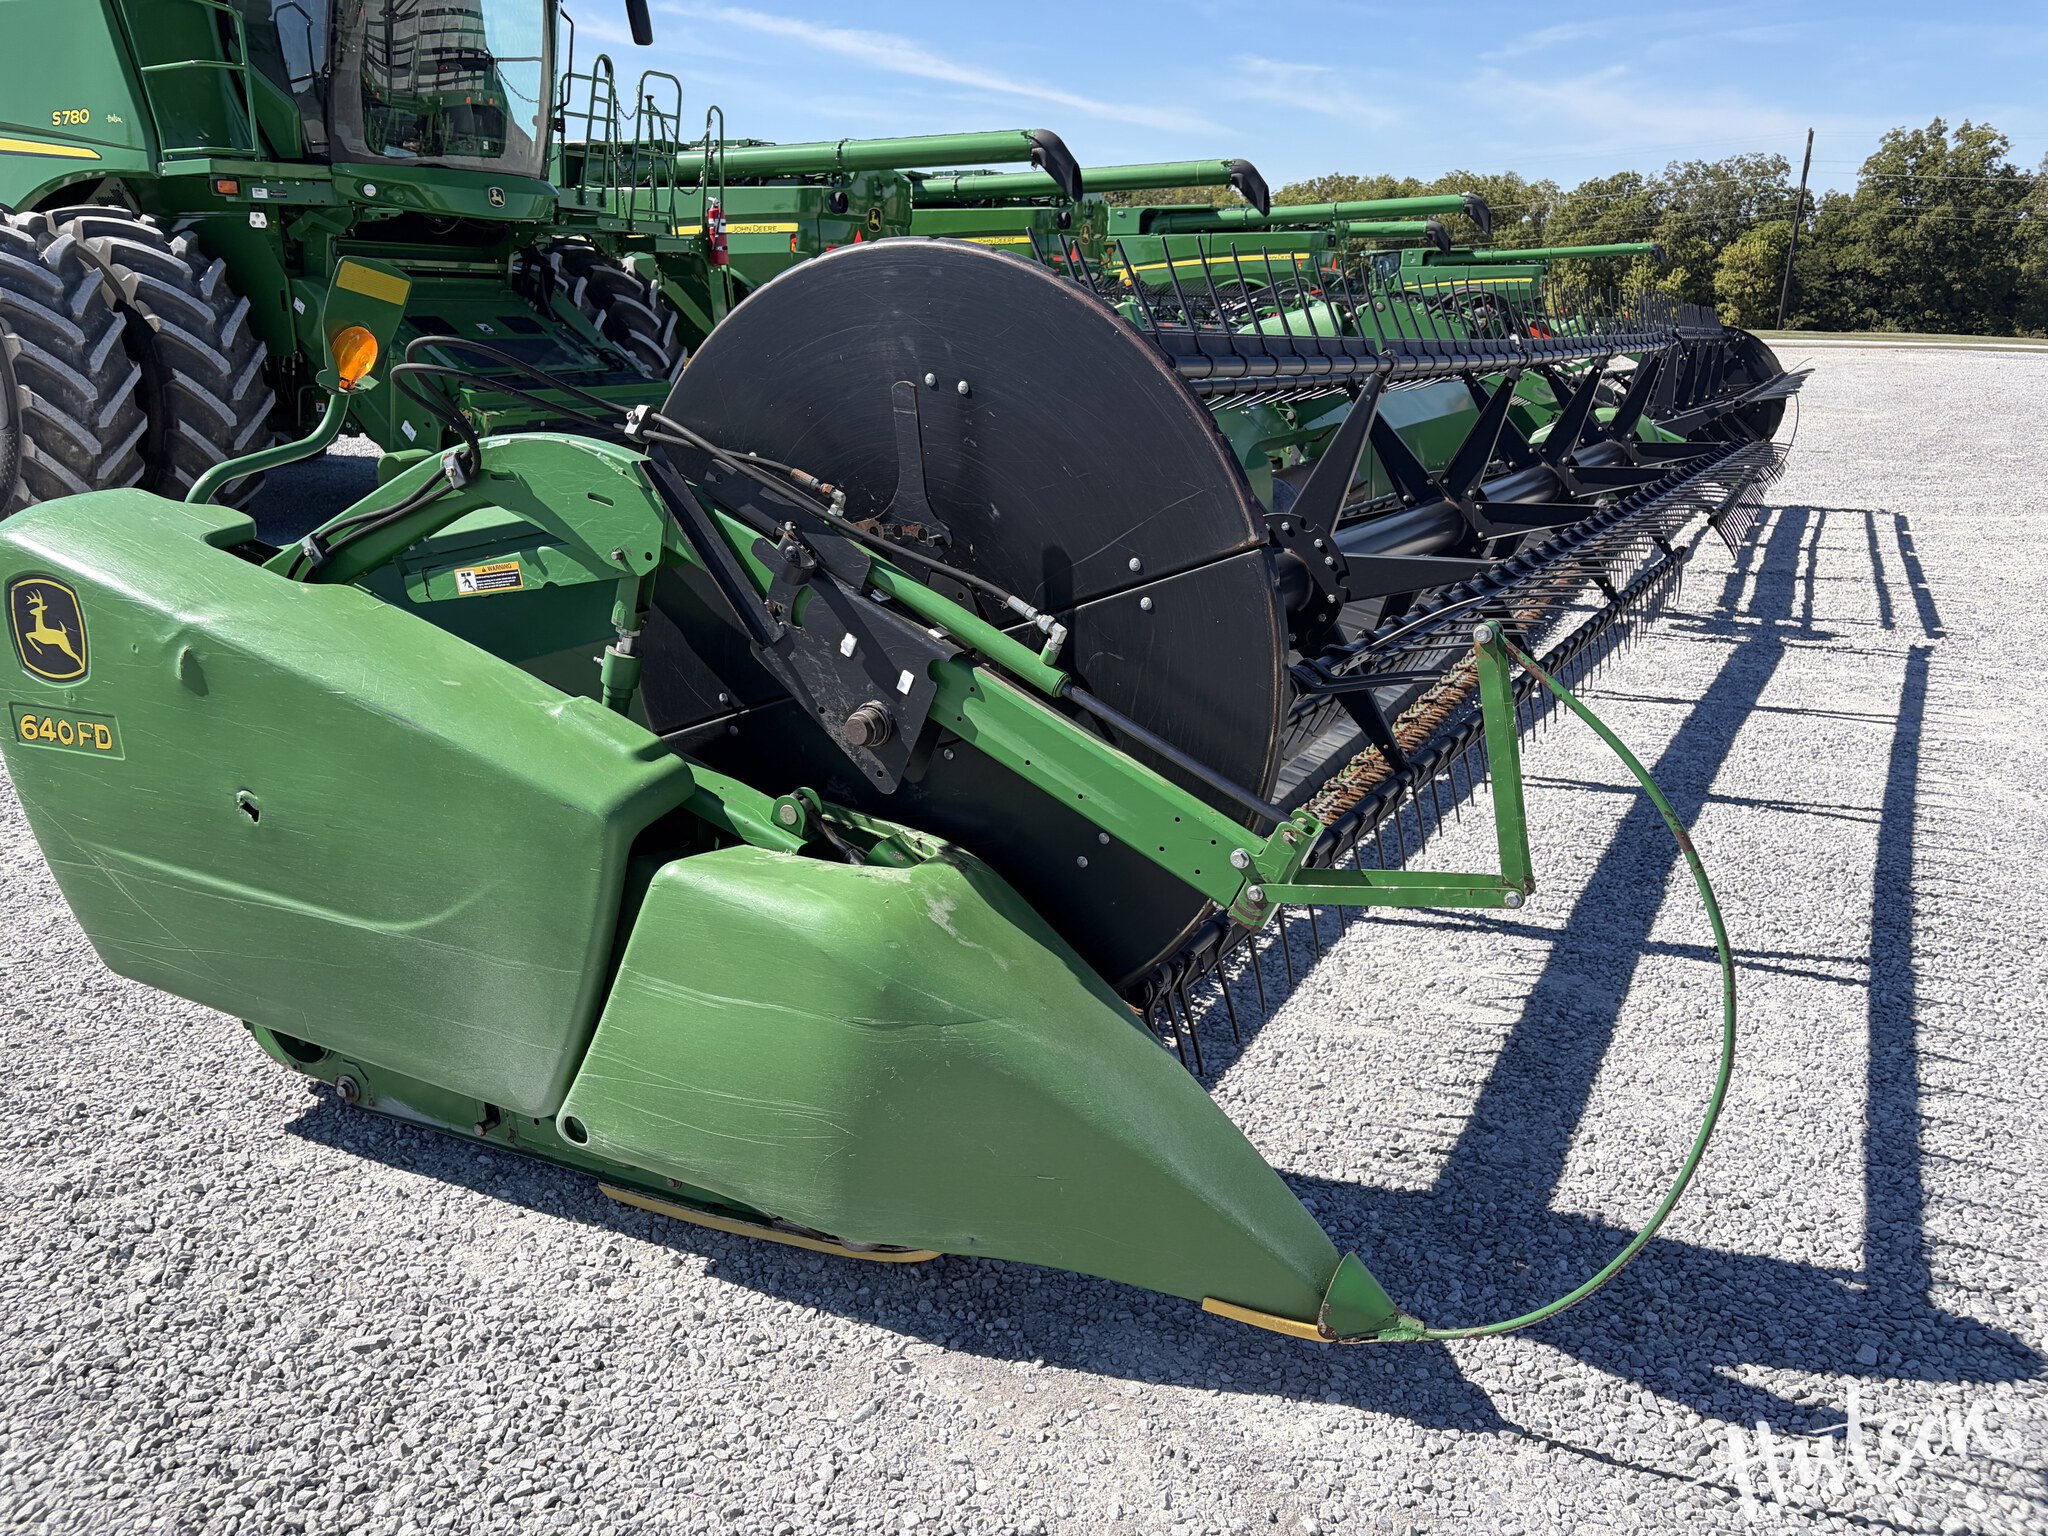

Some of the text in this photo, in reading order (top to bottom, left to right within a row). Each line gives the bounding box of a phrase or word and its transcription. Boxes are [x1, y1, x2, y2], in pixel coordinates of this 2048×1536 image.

[52, 108, 90, 126] S780
[732, 225, 752, 233] JOHN
[487, 563, 512, 571] WARNING
[20, 714, 112, 750] 640FD
